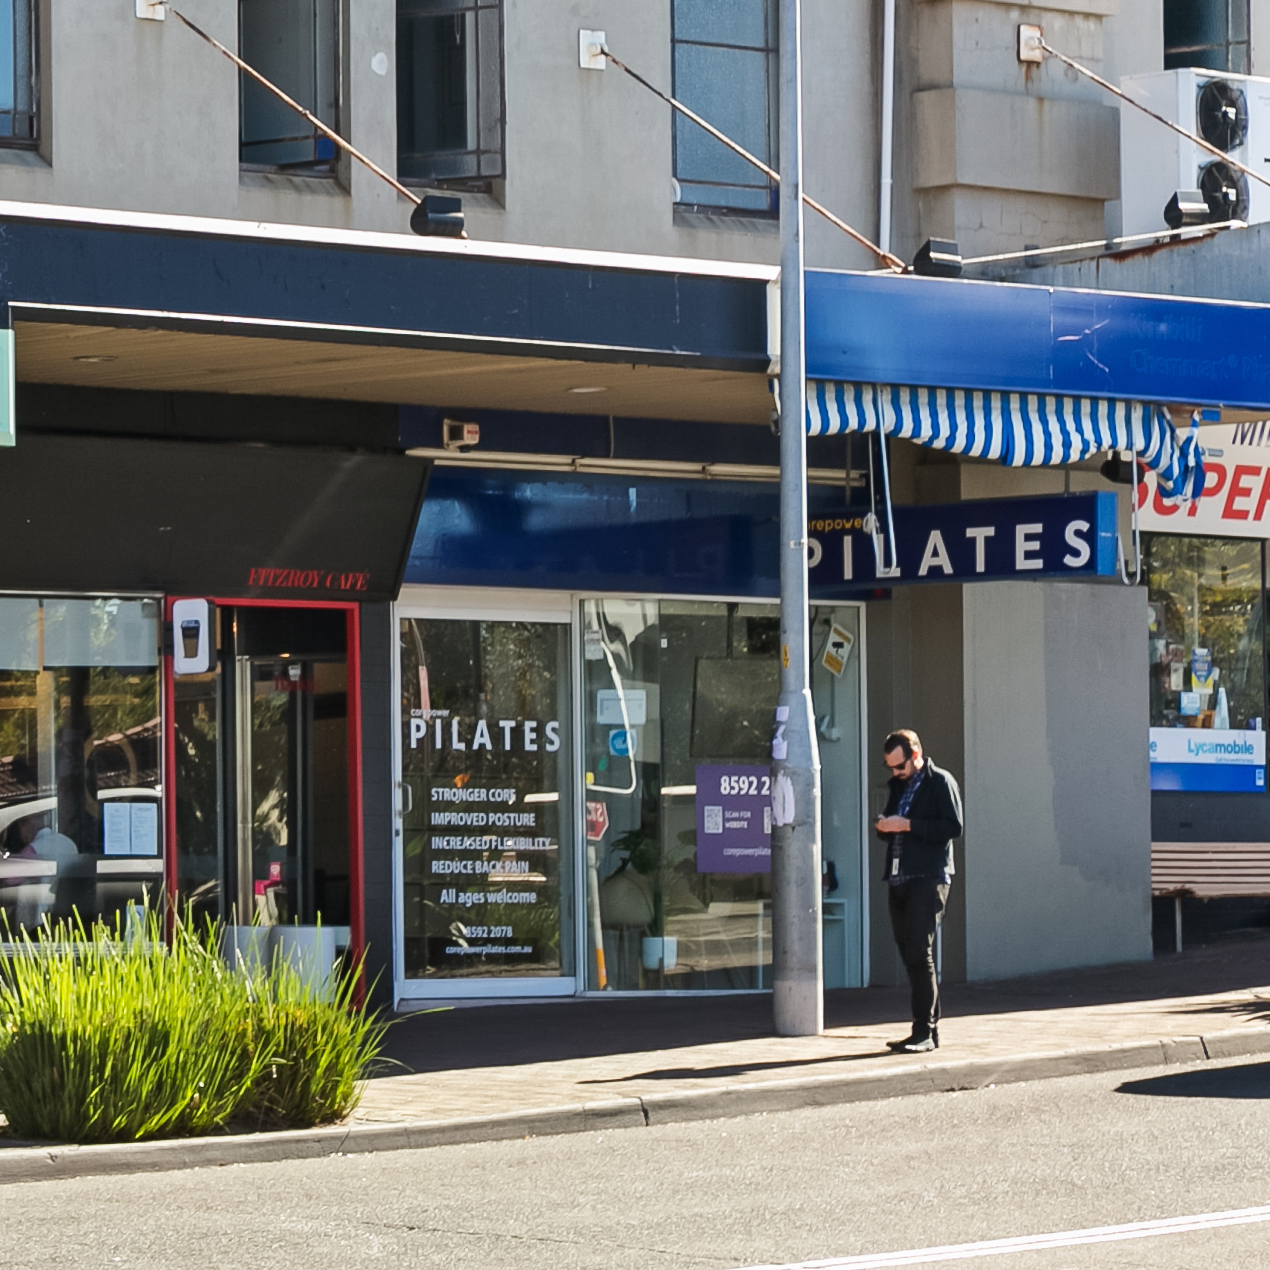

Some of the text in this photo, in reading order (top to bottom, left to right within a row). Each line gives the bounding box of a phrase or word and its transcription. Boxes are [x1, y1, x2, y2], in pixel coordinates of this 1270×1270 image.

[807, 519, 1092, 580] PILATES
[248, 567, 324, 588] FITZROY
[410, 718, 561, 752] PILATES
[1187, 738, 1254, 756] Lycamobile
[720, 775, 758, 795] 8592
[431, 788, 487, 801] STRONGER
[431, 812, 536, 826] IMPROVED POSTURE
[431, 836, 552, 850] INCREASED FLEXIBILITY
[431, 860, 530, 874] REDUCE BACK PAIN
[440, 888, 538, 907] All ages welcome
[465, 925, 513, 938] 8592 2078
